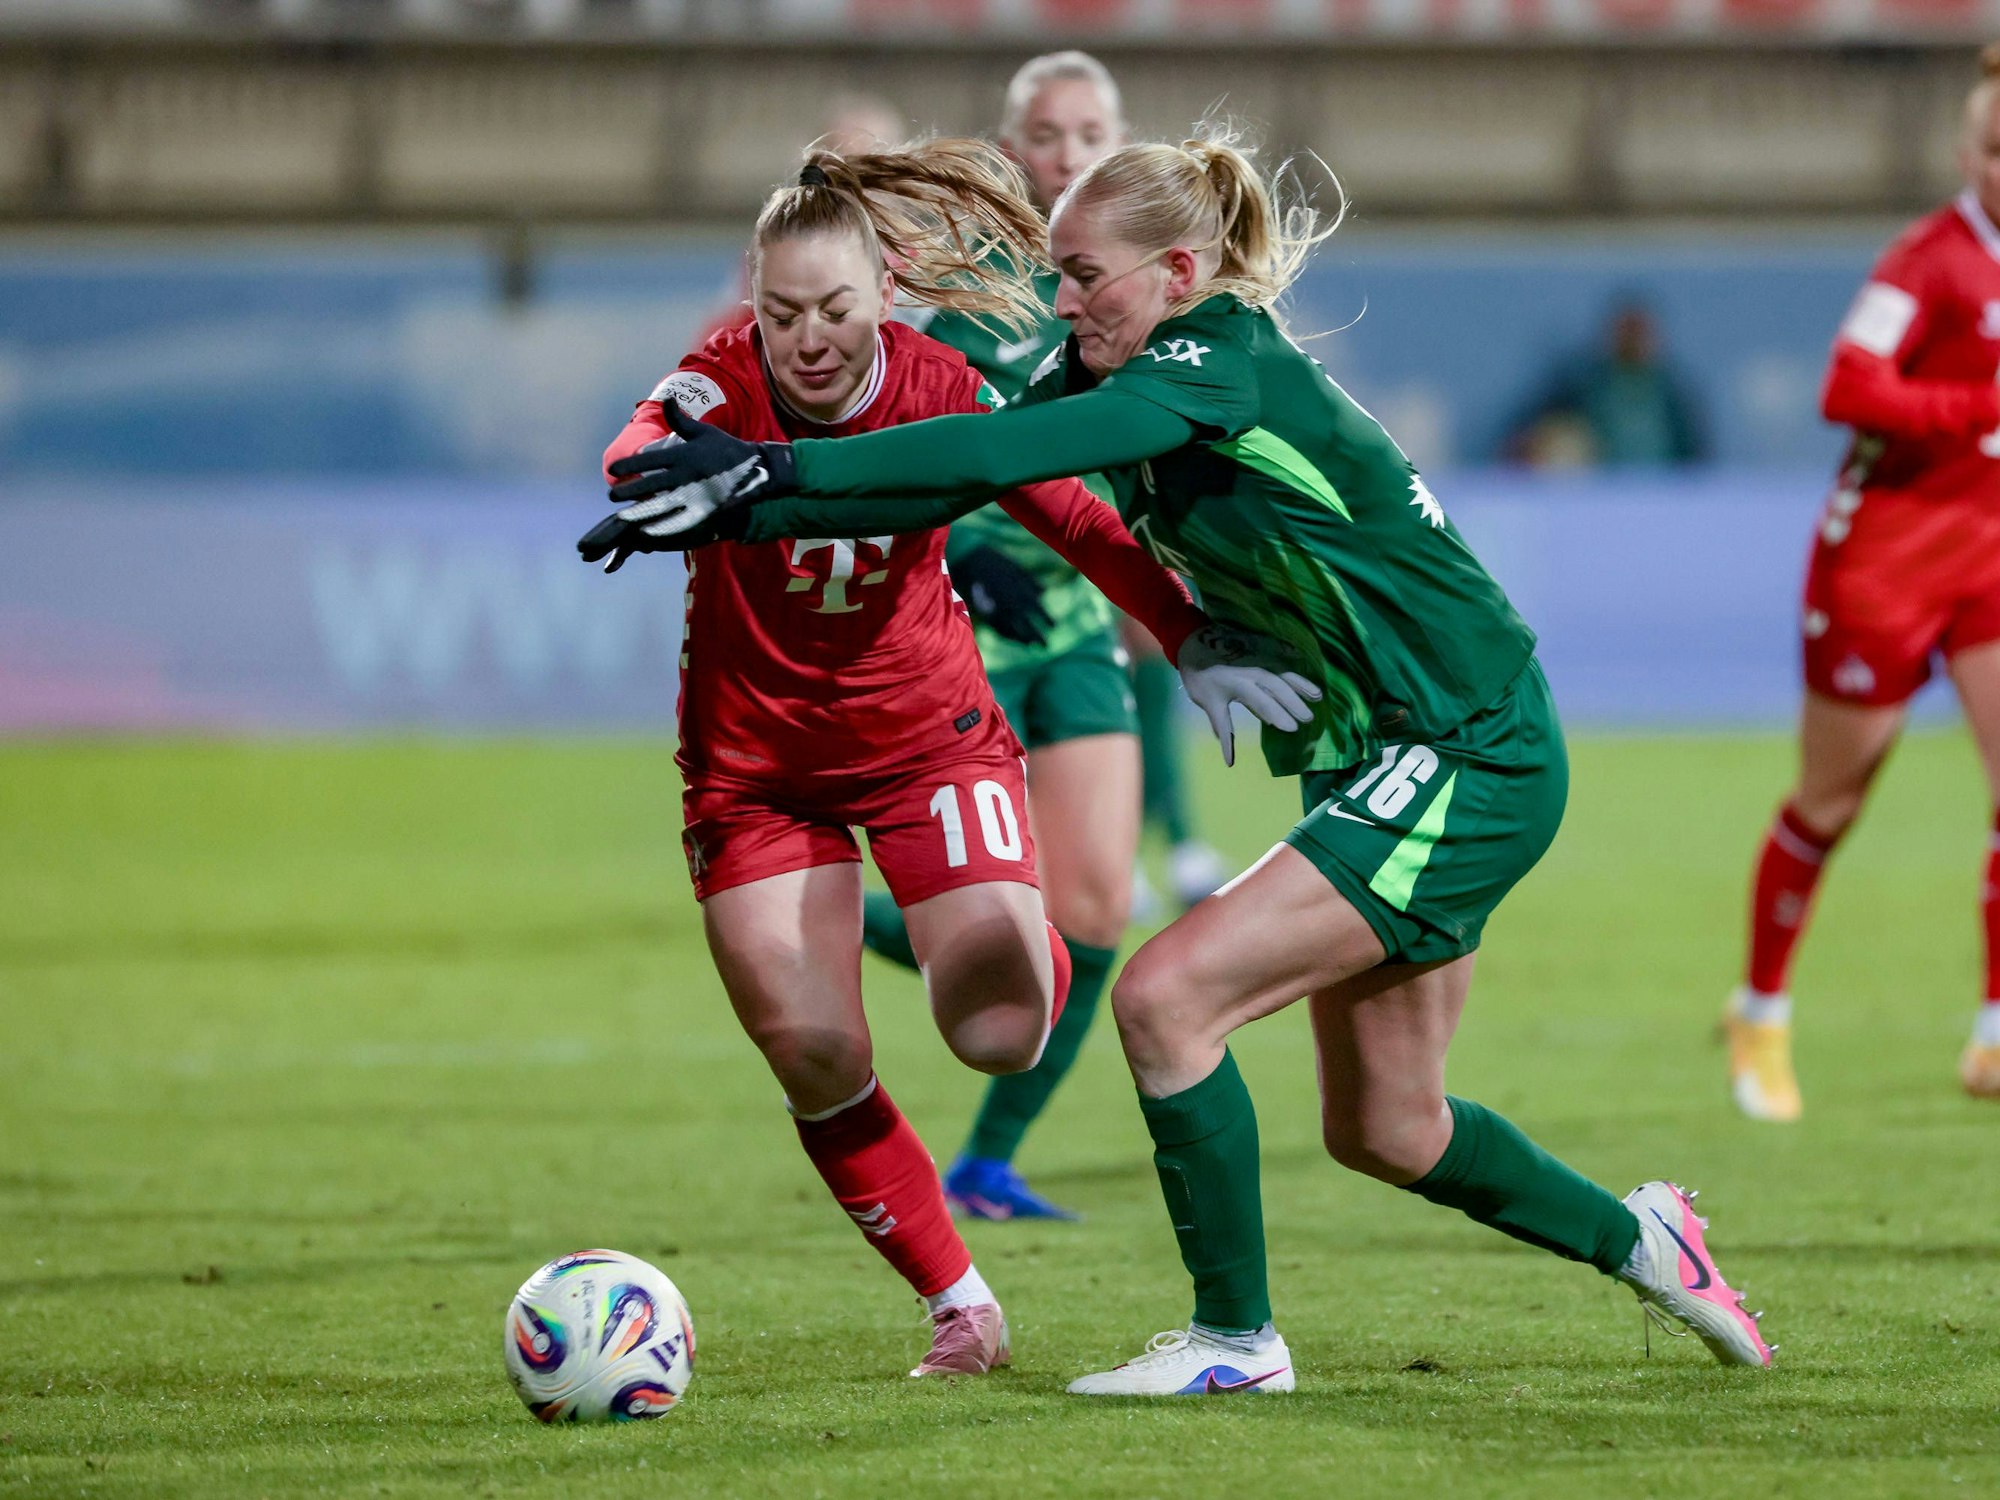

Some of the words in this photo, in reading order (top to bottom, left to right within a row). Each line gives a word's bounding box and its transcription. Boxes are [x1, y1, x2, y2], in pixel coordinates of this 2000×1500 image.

[785, 535, 894, 614] T
[1344, 744, 1440, 820] 16
[929, 779, 1023, 868] 10
